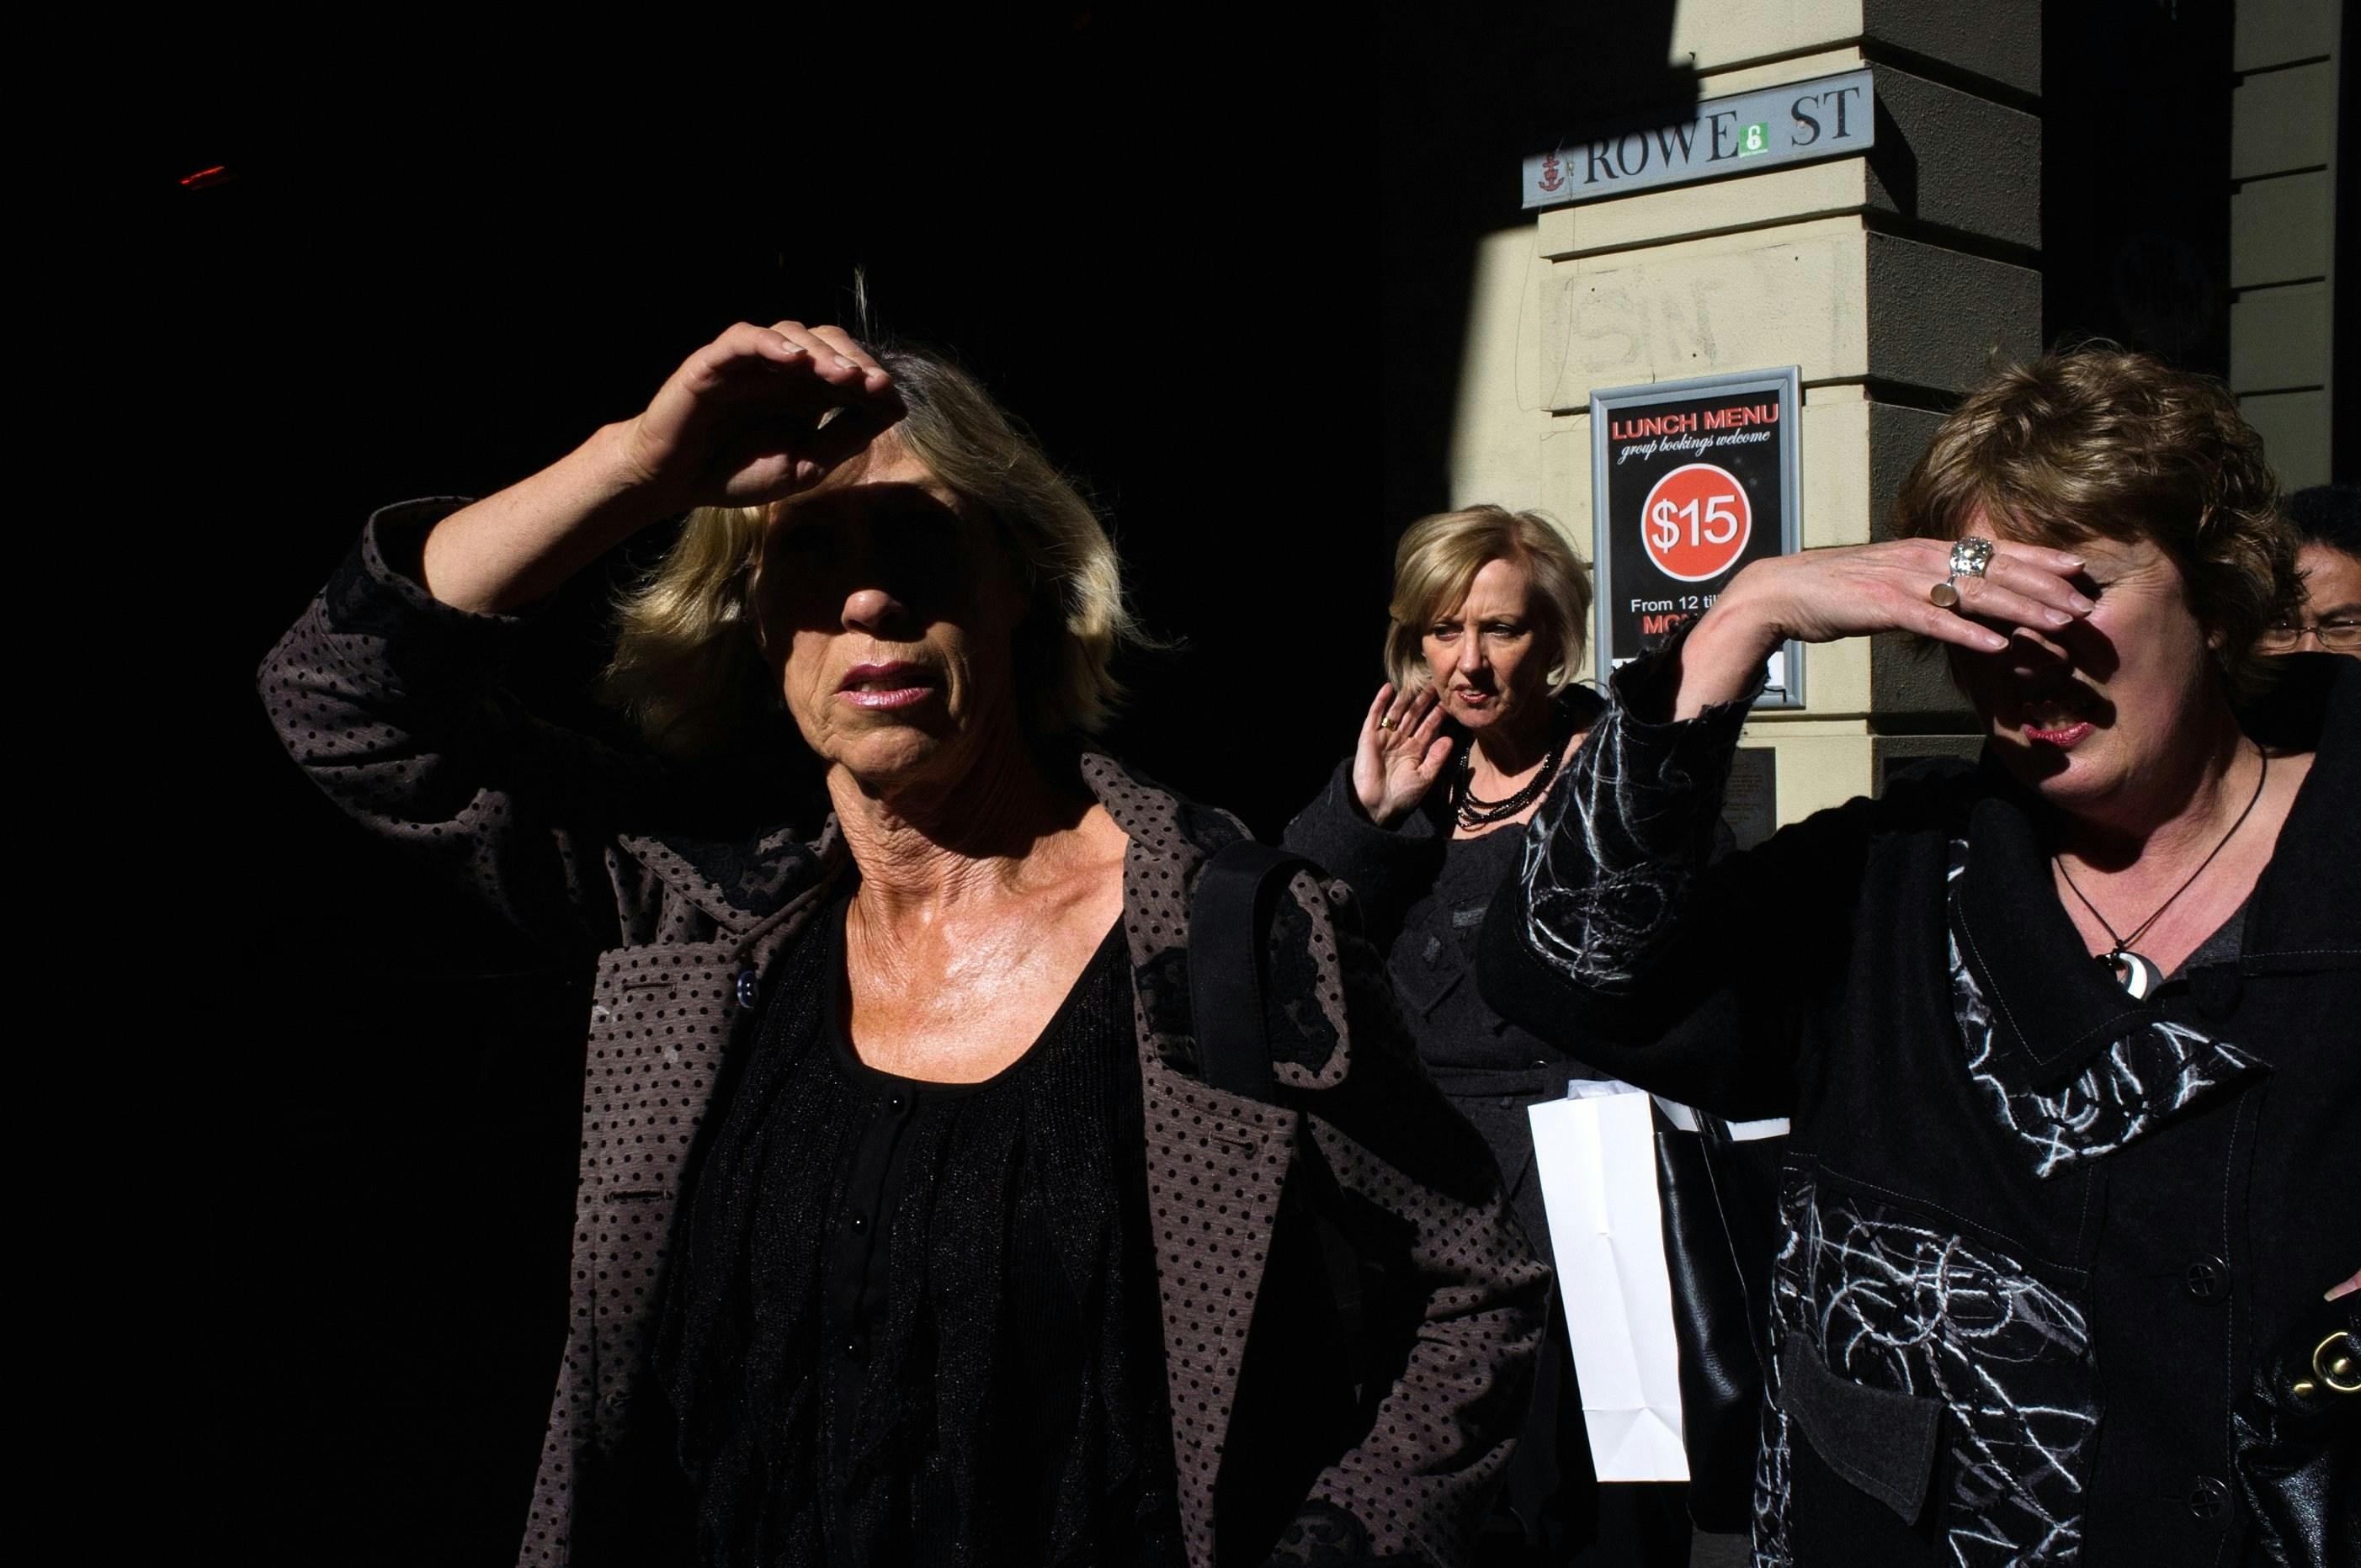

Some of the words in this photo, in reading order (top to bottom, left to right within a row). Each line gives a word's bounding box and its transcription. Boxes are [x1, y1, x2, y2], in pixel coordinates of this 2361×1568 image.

[1583, 110, 1741, 184] ROWE
[1791, 87, 1859, 148] ST
[1612, 412, 1697, 440] LUNCH
[1704, 403, 1779, 431] MENU
[1617, 440, 1657, 465] group
[1659, 433, 1714, 457] bookings
[1716, 428, 1771, 445] welcome
[1651, 495, 1738, 554] $15
[1631, 598, 1673, 613] From
[1678, 596, 1699, 610] 12
